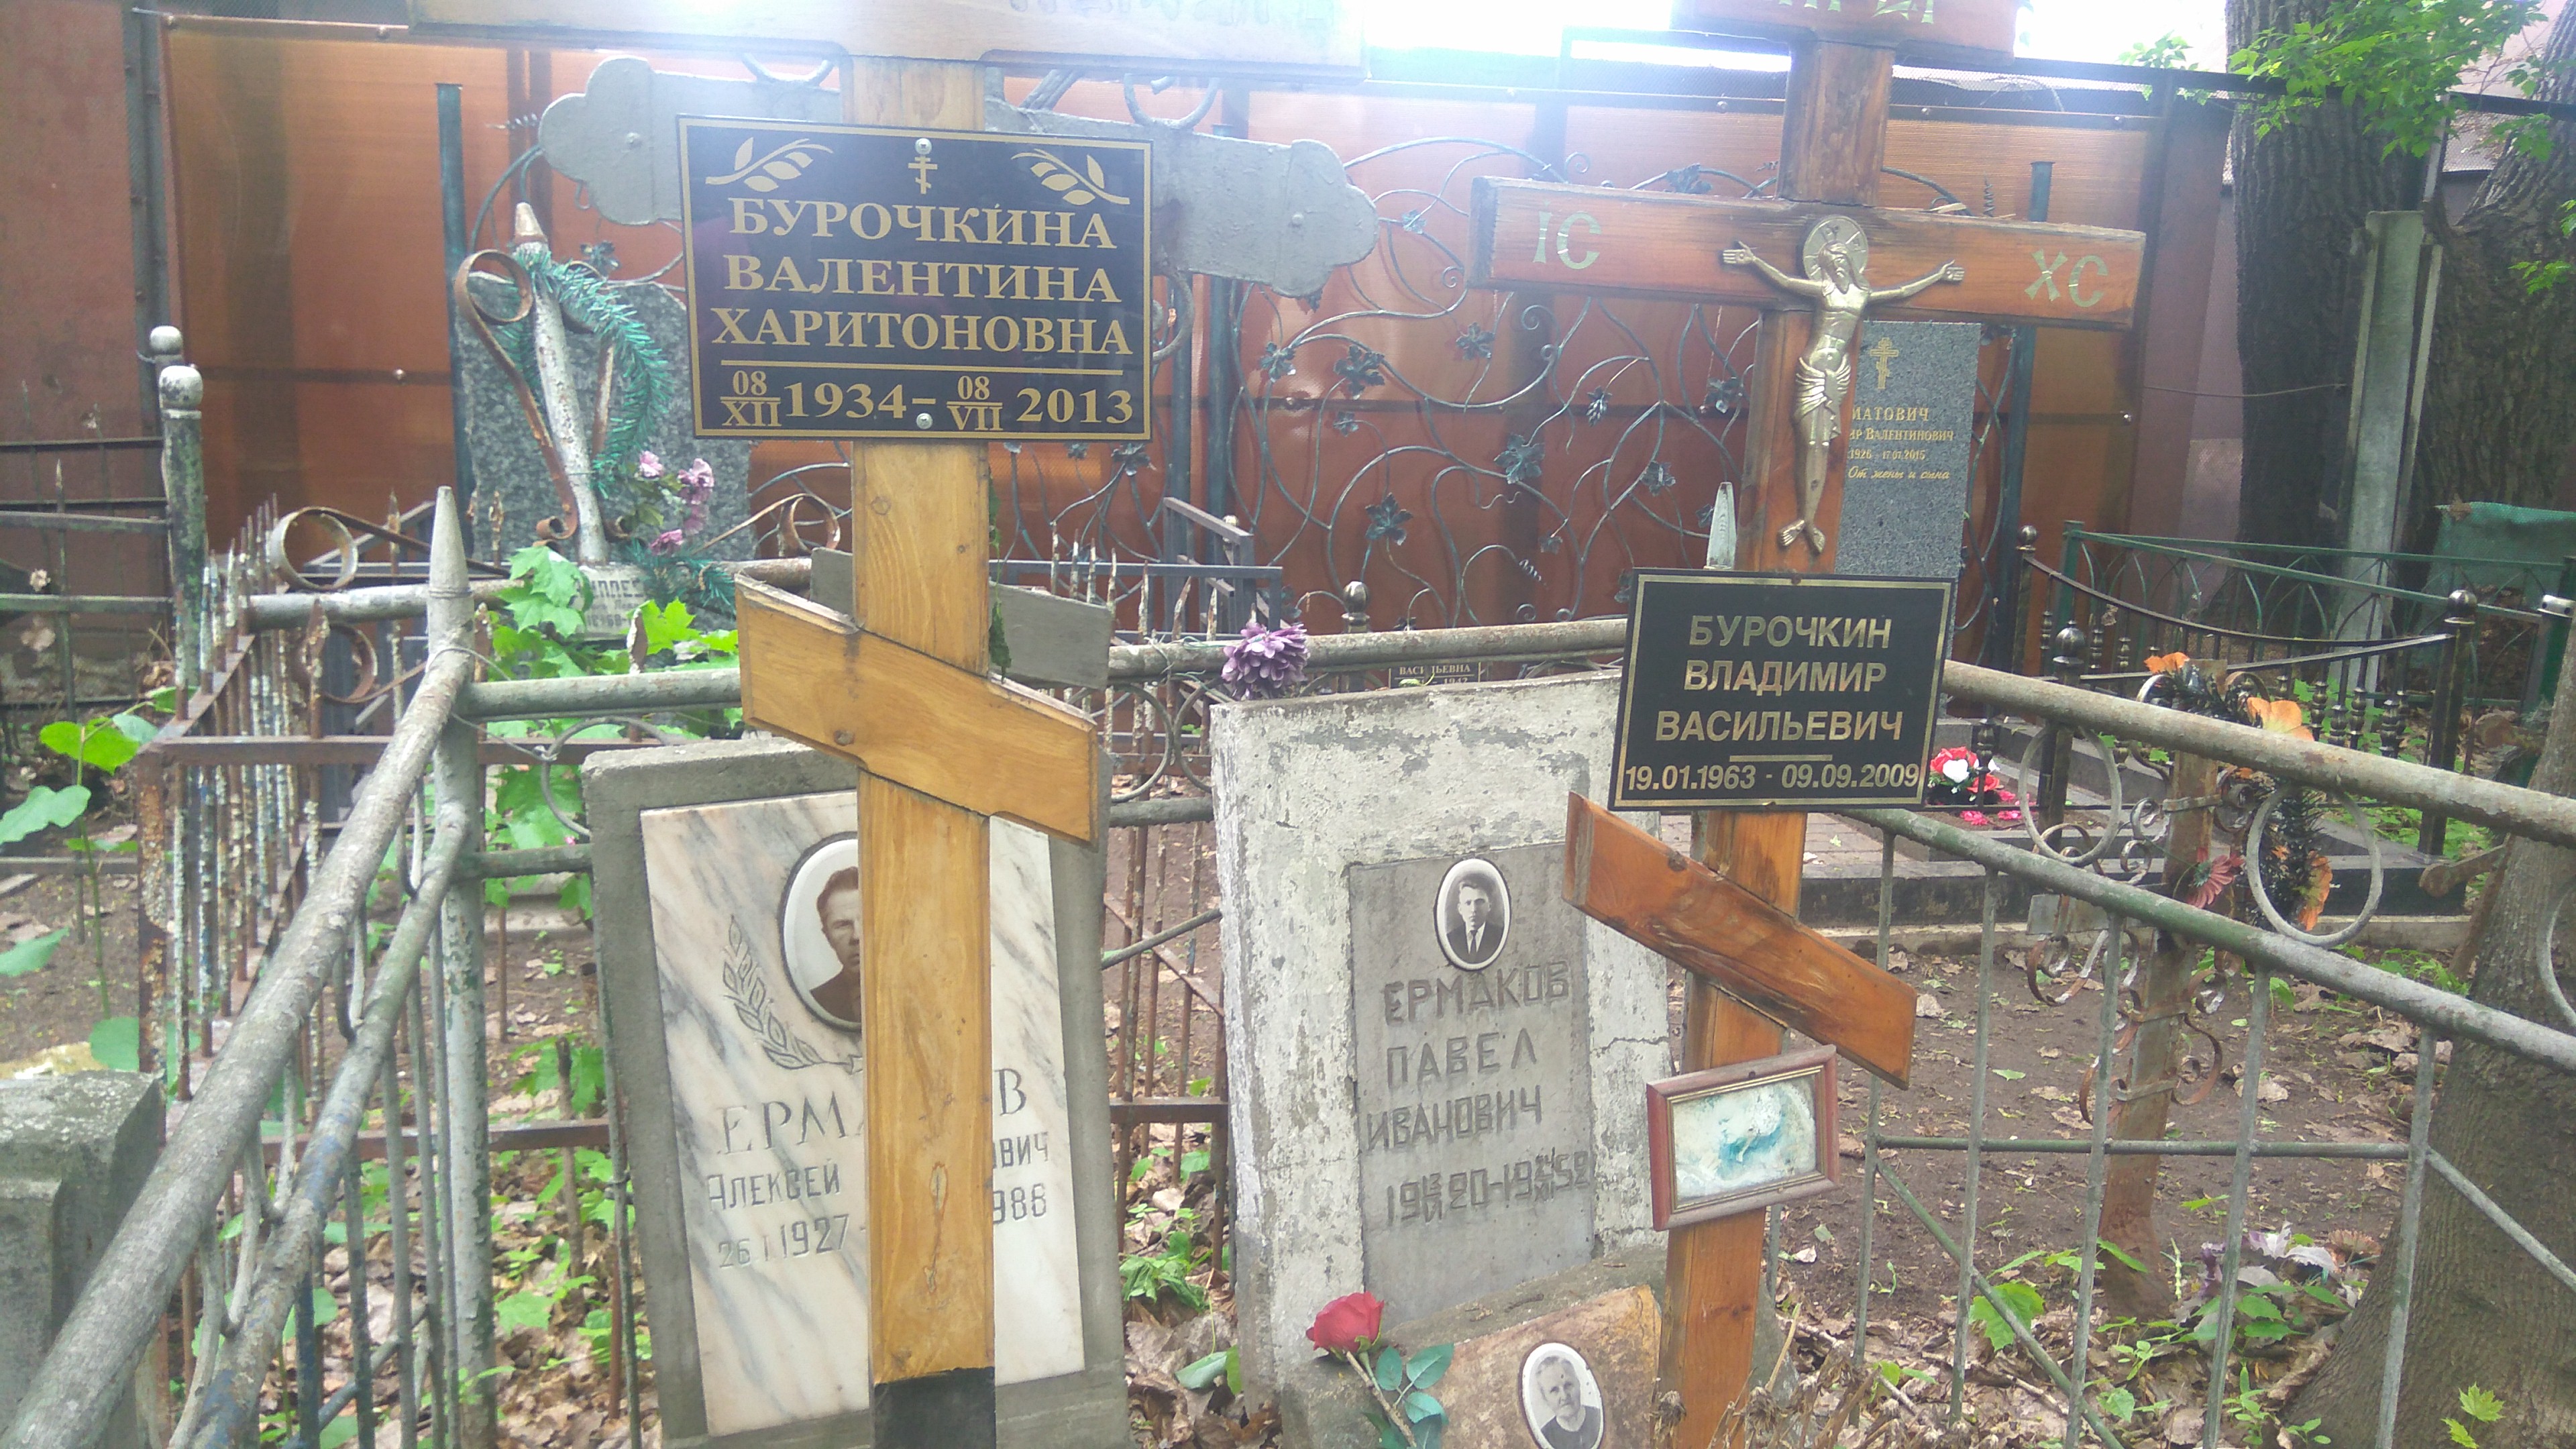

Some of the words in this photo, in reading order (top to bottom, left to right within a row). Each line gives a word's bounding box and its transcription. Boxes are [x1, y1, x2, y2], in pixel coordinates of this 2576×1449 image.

[728, 198, 1116, 249] БУРОЧКИНА
[723, 254, 1121, 303] ВАЛЕНТИНА
[711, 307, 1133, 356] ХАРИТОНОВНА
[1016, 387, 1133, 424] 2013
[1689, 614, 1891, 649] БУРОЧКИН
[1684, 660, 1886, 696] ВЛАДИМИР
[1656, 710, 1902, 741] ВАСИЛЬЕВИЧ
[1625, 765, 1756, 790] 19.01.1963
[1781, 763, 1919, 788] 09.09.2009
[1384, 961, 1570, 1026] ЕРМАКОВ
[1387, 1028, 1536, 1089] ПАВЕЛ
[1366, 1085, 1542, 1150] ИВАНОВИЧ
[708, 1159, 840, 1210] АЛЕКСЕЙ
[780, 1213, 851, 1258] 1927
